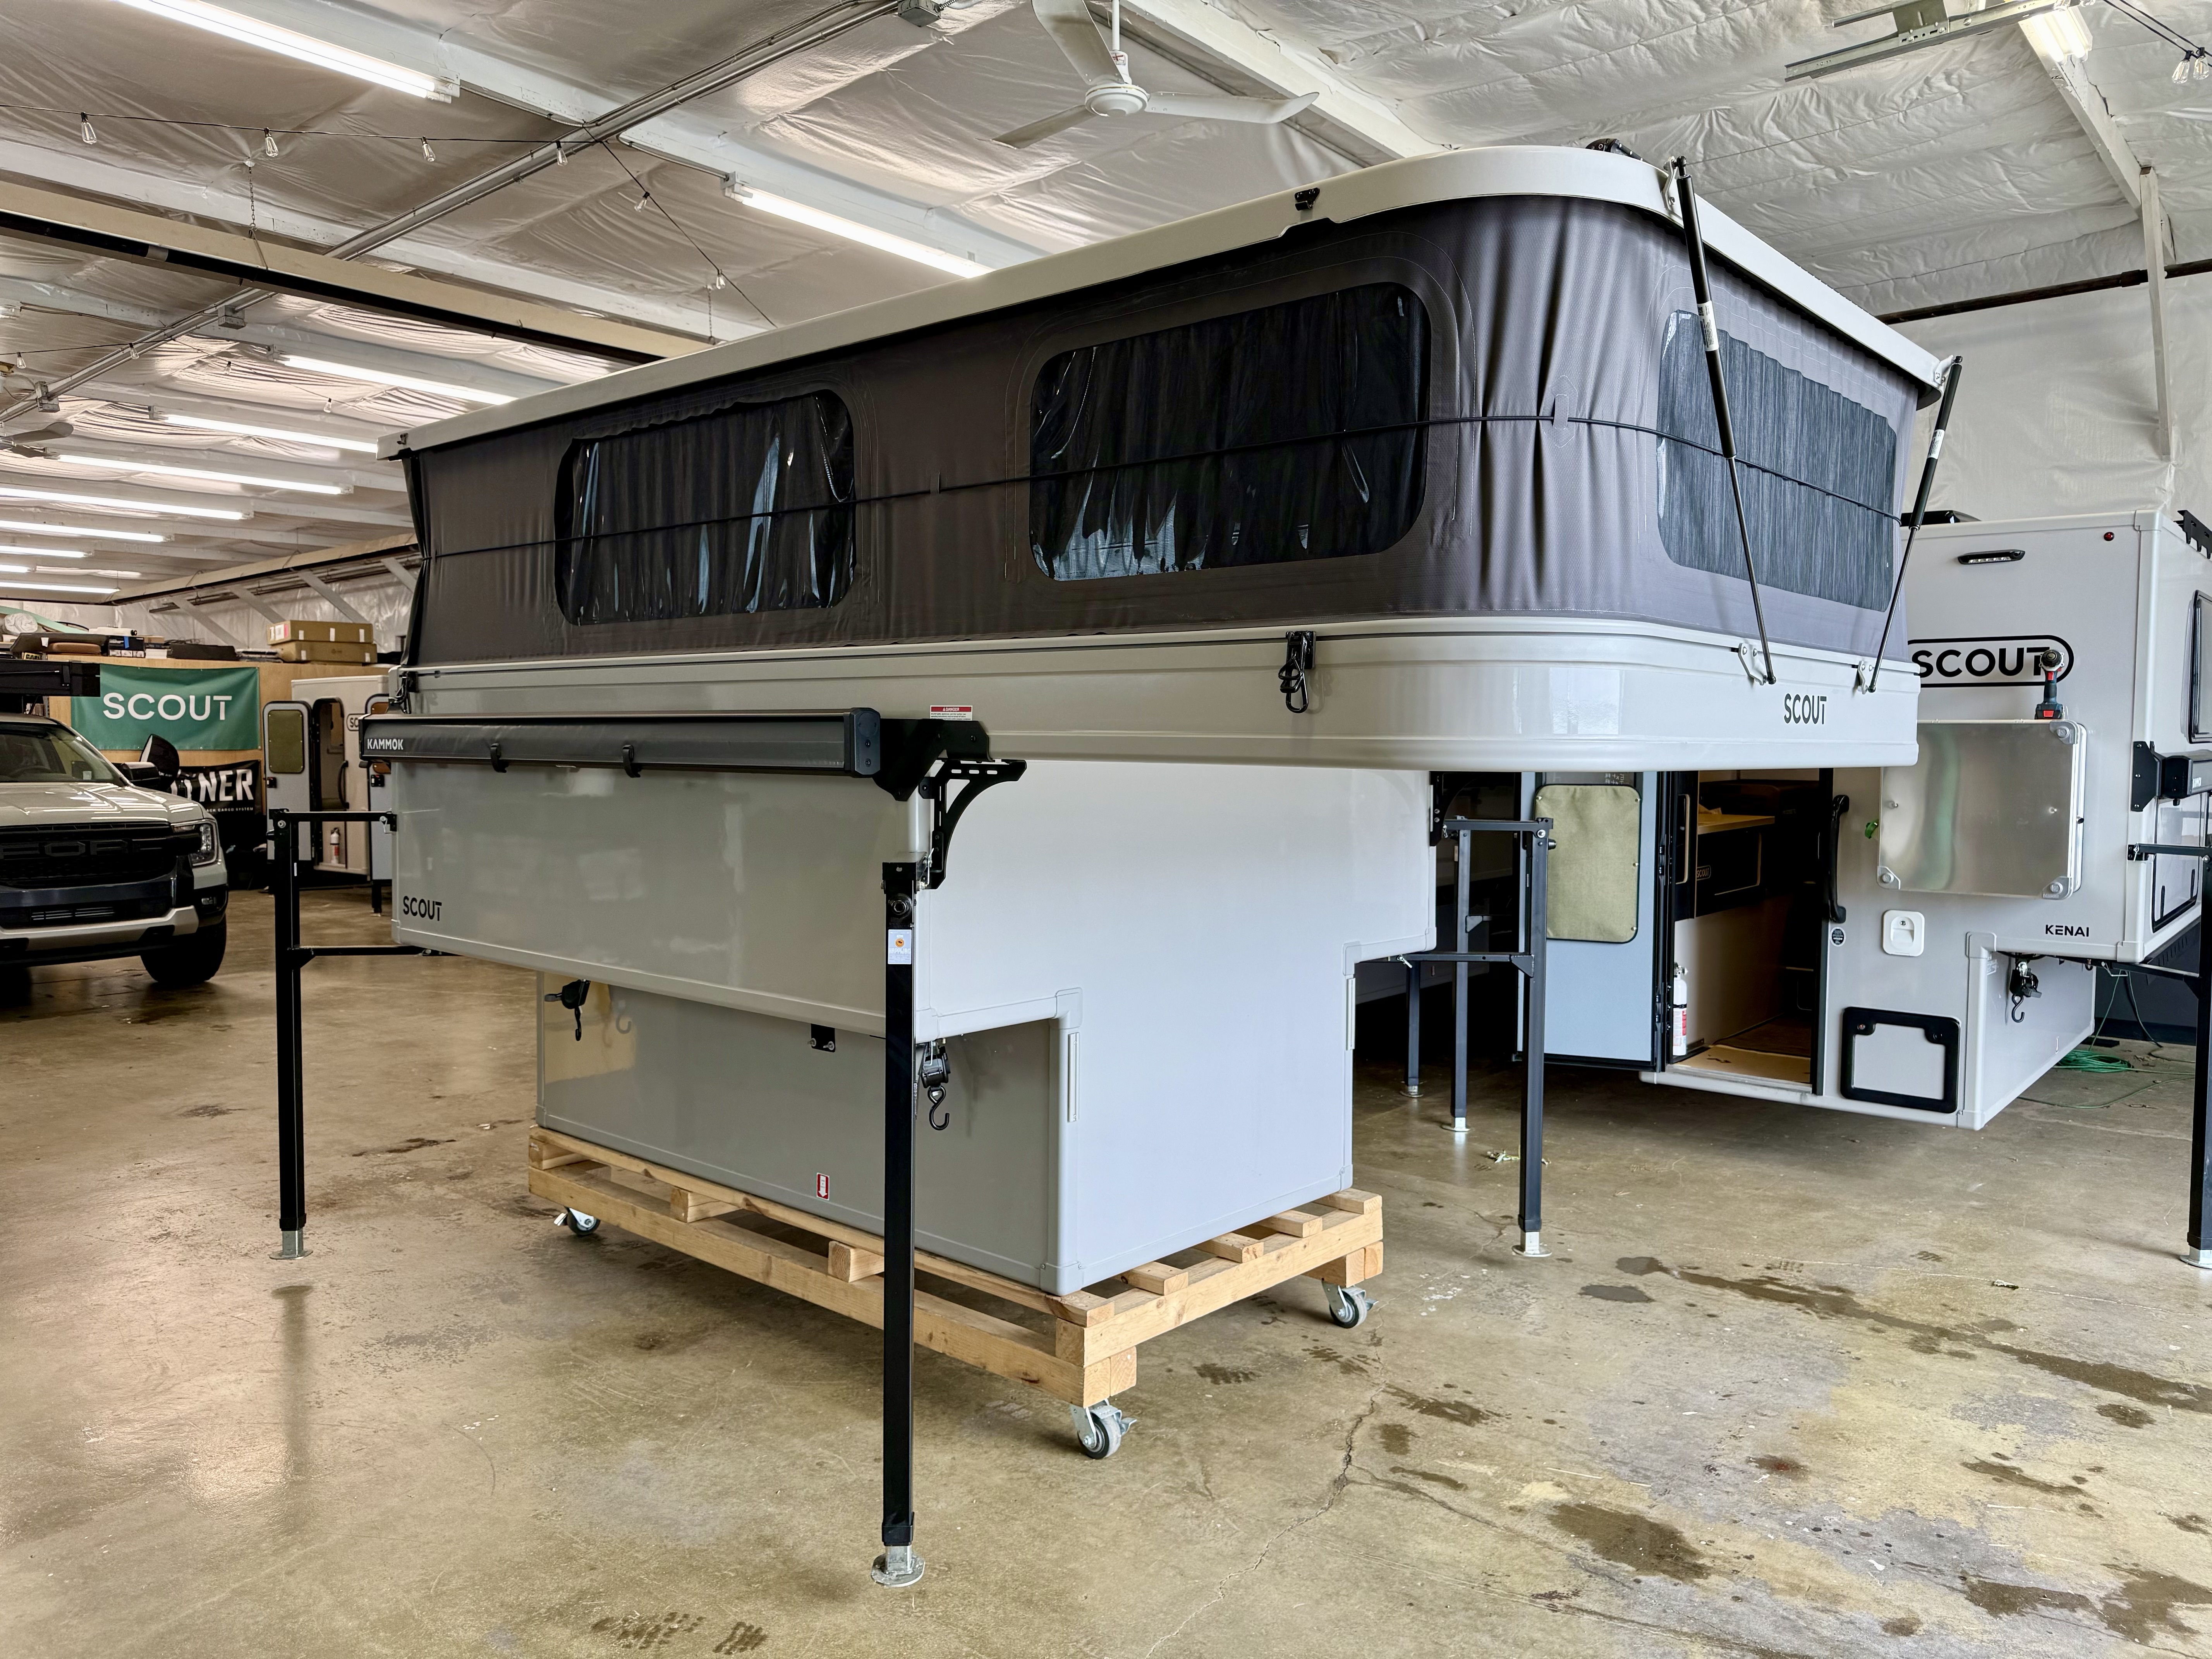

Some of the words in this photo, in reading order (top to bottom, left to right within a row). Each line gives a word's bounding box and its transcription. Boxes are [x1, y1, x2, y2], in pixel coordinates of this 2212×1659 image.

[1911, 646, 2050, 678] SCOUT
[103, 692, 232, 721] SCOUT
[1784, 693, 1827, 725] SCOUT
[367, 738, 404, 750] KAMMOK
[403, 895, 442, 921] SCOUT
[2045, 924, 2089, 937] KENAI
